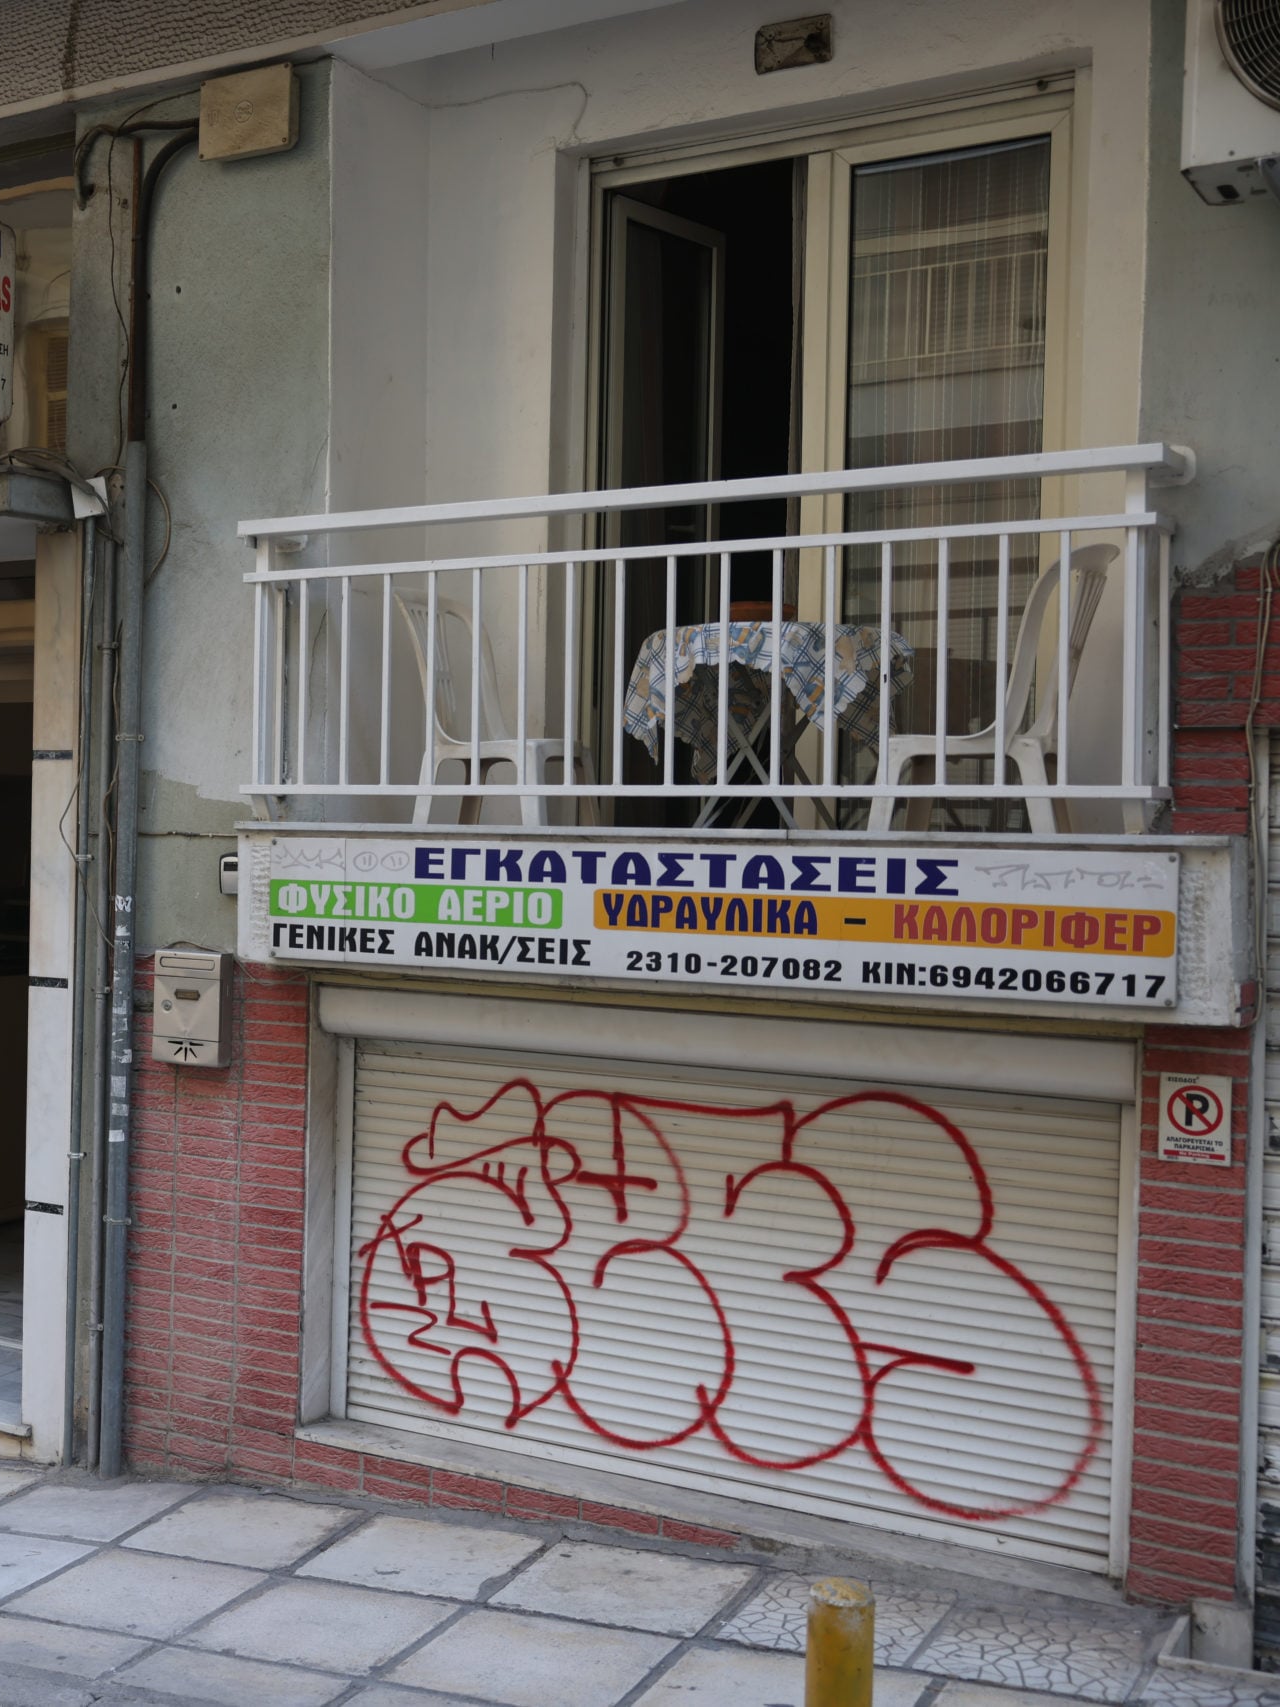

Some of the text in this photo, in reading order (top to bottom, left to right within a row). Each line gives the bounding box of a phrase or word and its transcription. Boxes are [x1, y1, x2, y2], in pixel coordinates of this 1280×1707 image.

[414, 846, 960, 897] ΕΓΚΑΤΑΣΤΑΣΕΙΣ
[277, 883, 416, 919] ΦΥΣΙΚΟ
[437, 887, 554, 926] ΑΕΡΙΟ
[601, 892, 819, 936] ΥΔΡΑΥΛΙΚΑ
[892, 903, 1163, 953] ΚΑΛΟΡΙΦΕΡ
[272, 922, 396, 955] ΓΕΝΙΚΕΣ
[413, 930, 592, 967] ΑΝΑΚ/ΣΕΙΣ
[626, 950, 844, 984] 2310-207082
